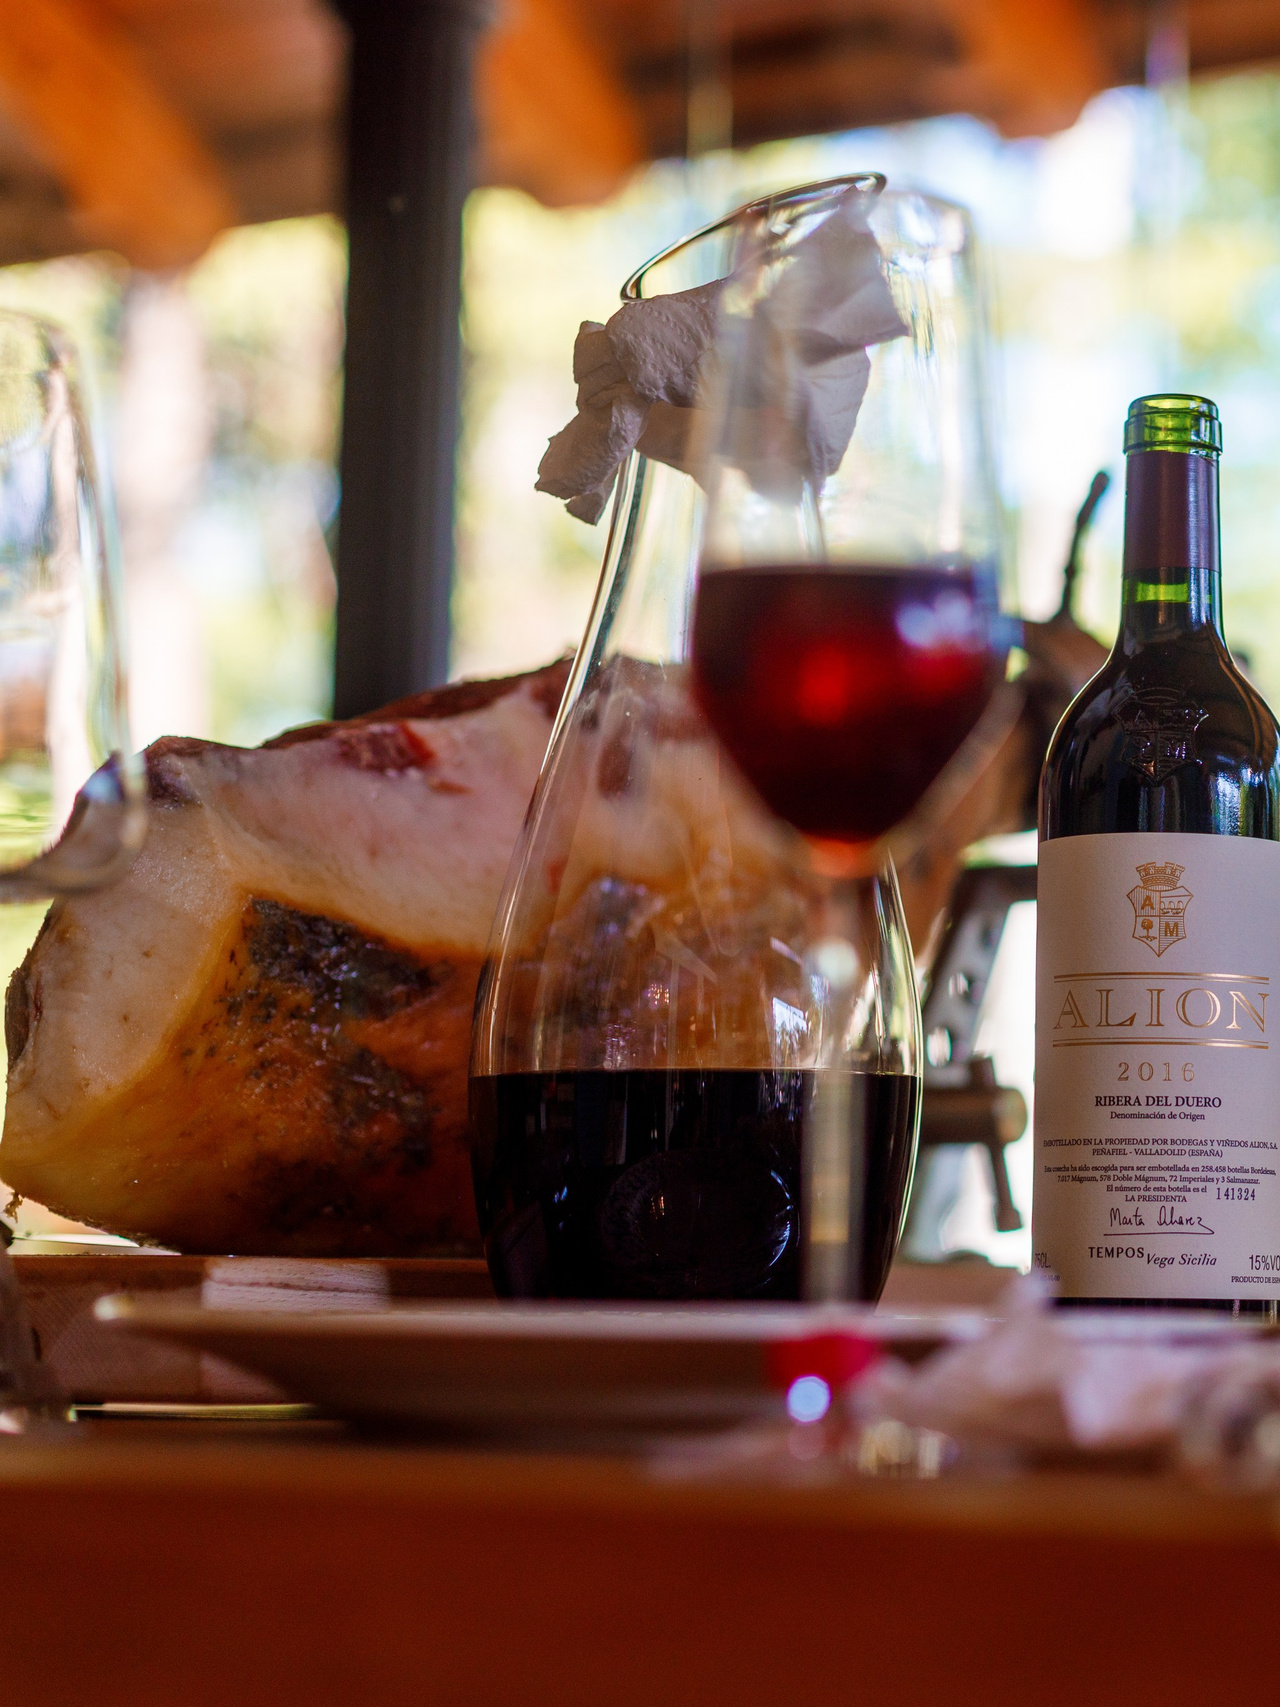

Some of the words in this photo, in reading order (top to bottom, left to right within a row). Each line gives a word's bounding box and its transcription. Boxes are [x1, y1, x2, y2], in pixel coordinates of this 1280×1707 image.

[1140, 894, 1155, 911] A
[1164, 921, 1179, 937] M
[1053, 988, 1270, 1033] ALION
[1117, 1061, 1195, 1083] 2016
[1094, 1095, 1142, 1107] RIBERA
[1145, 1095, 1172, 1107] DEL
[1175, 1096, 1222, 1108] DUERO
[1110, 1111, 1166, 1120] Denominación
[1167, 1111, 1178, 1120] de
[1179, 1112, 1206, 1122] Origen
[1083, 1138, 1092, 1146] EN
[1093, 1138, 1103, 1146] LA
[1104, 1138, 1150, 1146] PROPIEDAD
[1151, 1138, 1169, 1146] POR
[1170, 1138, 1208, 1147] BODEGAS
[1210, 1139, 1215, 1147] Y
[1216, 1138, 1248, 1148] VIÑEDOS
[1249, 1141, 1270, 1150] ALION,
[1092, 1147, 1128, 1156] PEÑAFIEL
[1134, 1148, 1187, 1156] VALLADOLID
[1188, 1148, 1223, 1158] (ESPAÑA)
[1091, 1164, 1118, 1173] escogida
[1119, 1165, 1135, 1173] para
[1148, 1164, 1190, 1172] embotellada
[1201, 1165, 1227, 1173] 258.458
[1227, 1165, 1250, 1174] botellas
[1113, 1174, 1132, 1182] Doble
[1134, 1175, 1168, 1183] Mágnum,
[1179, 1175, 1215, 1184] Imperiales
[1215, 1177, 1220, 1185] y
[1168, 1185, 1191, 1193] botella
[1216, 1187, 1256, 1201] 141324
[1088, 1246, 1145, 1259] TEMPOS
[1146, 1253, 1175, 1269] Vega
[1178, 1253, 1217, 1266] Sicilia
[1231, 1275, 1264, 1284] PRODUCTO
[1265, 1276, 1272, 1284] DE
